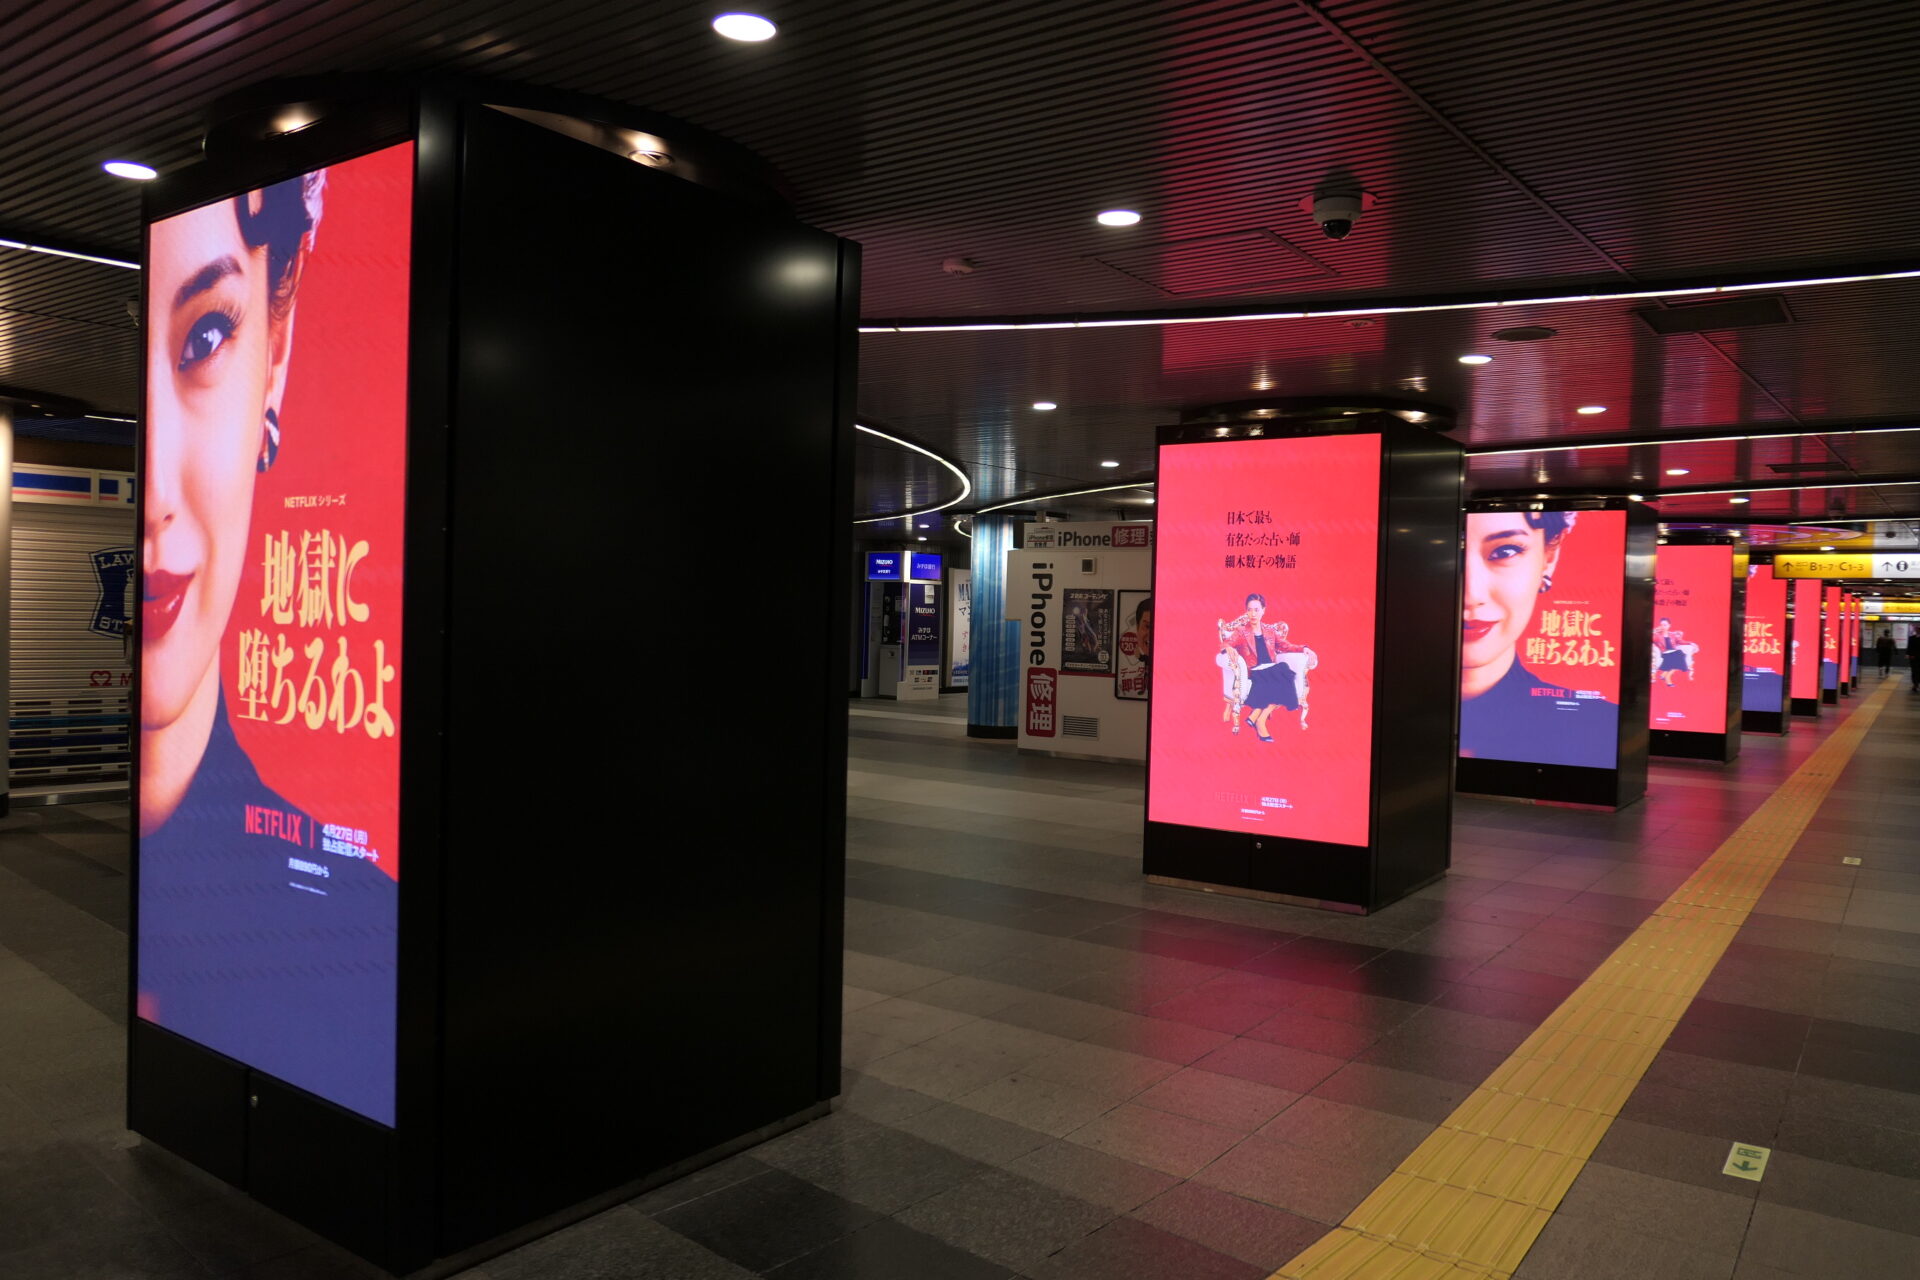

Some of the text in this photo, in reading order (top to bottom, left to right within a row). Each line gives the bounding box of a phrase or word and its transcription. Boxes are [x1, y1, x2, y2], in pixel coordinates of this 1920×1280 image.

[1227, 510, 1273, 525] 日本で最も
[1058, 531, 1111, 546] iPhone
[1114, 528, 1146, 545] 修理
[1227, 531, 1301, 547] 有名だった占い師
[1225, 554, 1297, 569] 細木数子の物語
[260, 528, 370, 630] 地獄に
[1029, 562, 1054, 666] iPhone
[1540, 610, 1603, 638] 地獄に
[1525, 637, 1615, 667] 堕ちるわよ
[237, 628, 396, 739] 堕ちるわよ
[1530, 687, 1565, 698] NETFLIX
[1030, 673, 1055, 732] 修理
[245, 804, 303, 847] NETFLIX
